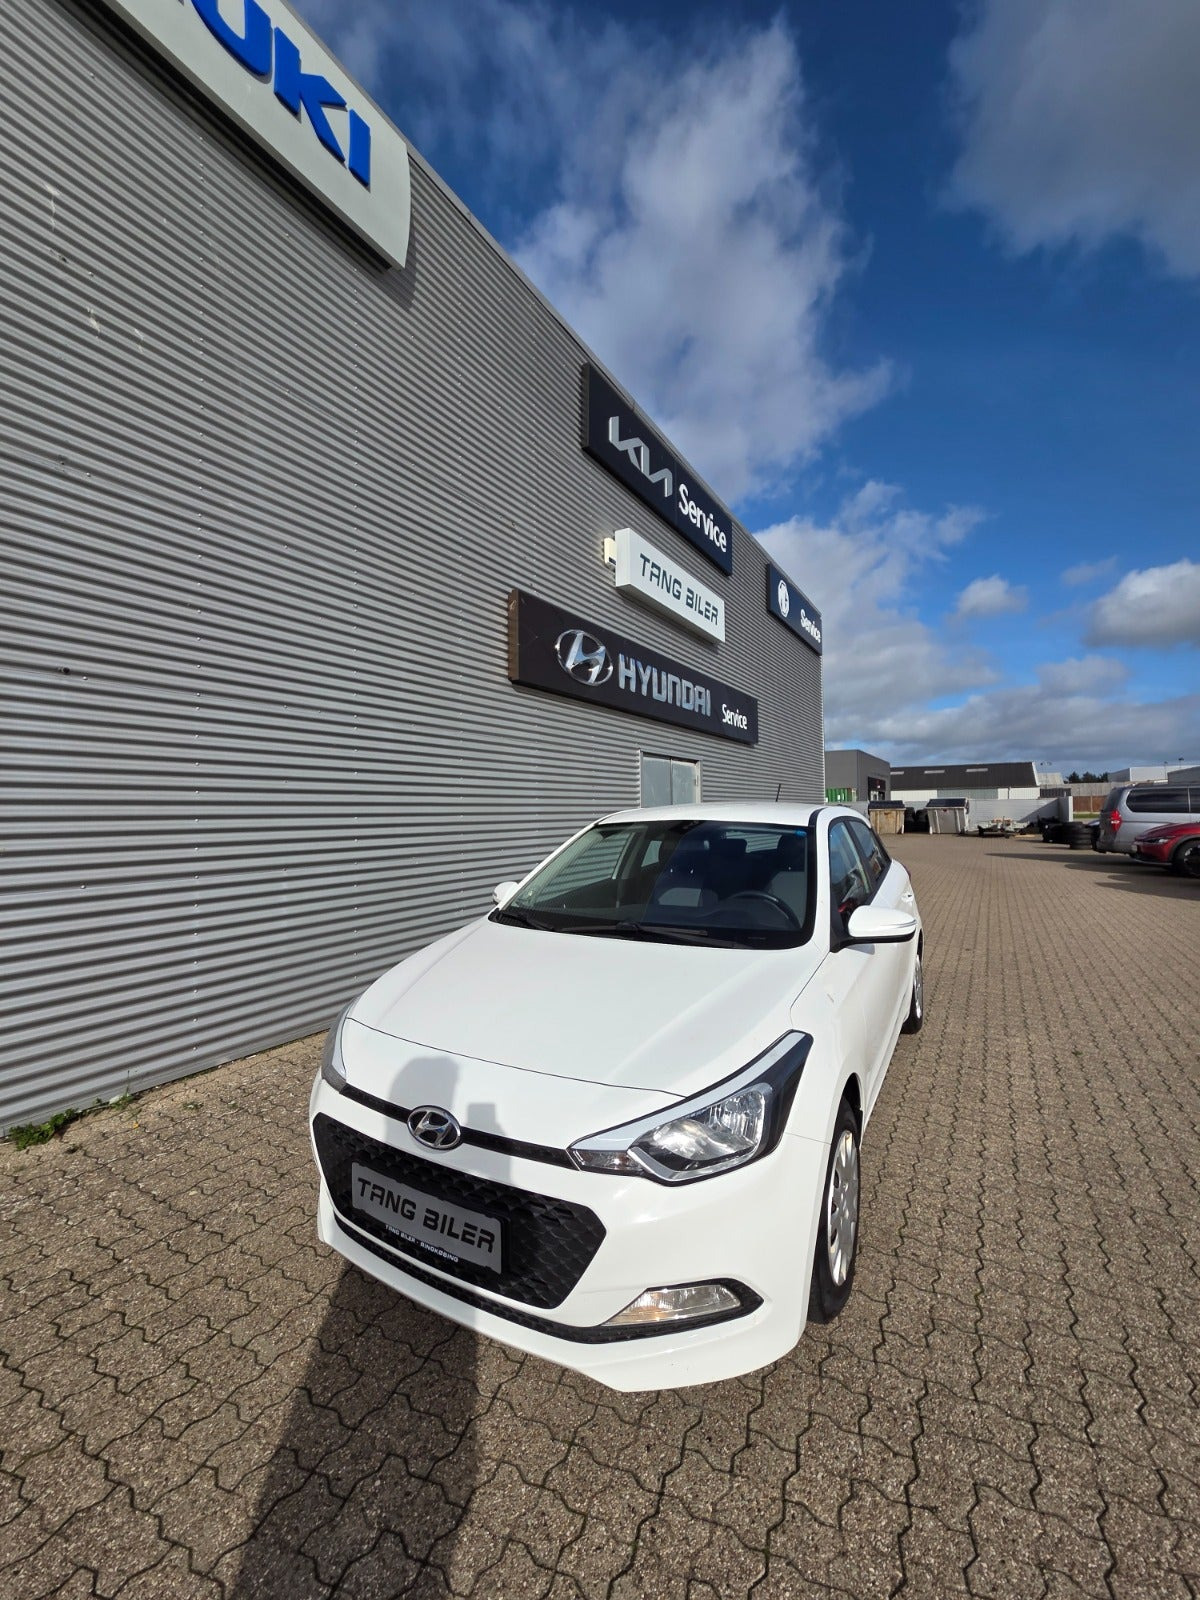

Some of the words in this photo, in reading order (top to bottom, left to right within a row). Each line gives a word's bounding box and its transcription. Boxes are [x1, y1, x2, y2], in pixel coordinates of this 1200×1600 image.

[678, 483, 727, 552] Service
[640, 553, 682, 601] TANG
[686, 587, 719, 626] BILER
[800, 608, 821, 643] Service
[618, 653, 711, 717] HYUNDAI
[721, 703, 748, 730] Service
[357, 1177, 417, 1221] TANG
[422, 1207, 496, 1253] BILER
[385, 1224, 400, 1236] TANG
